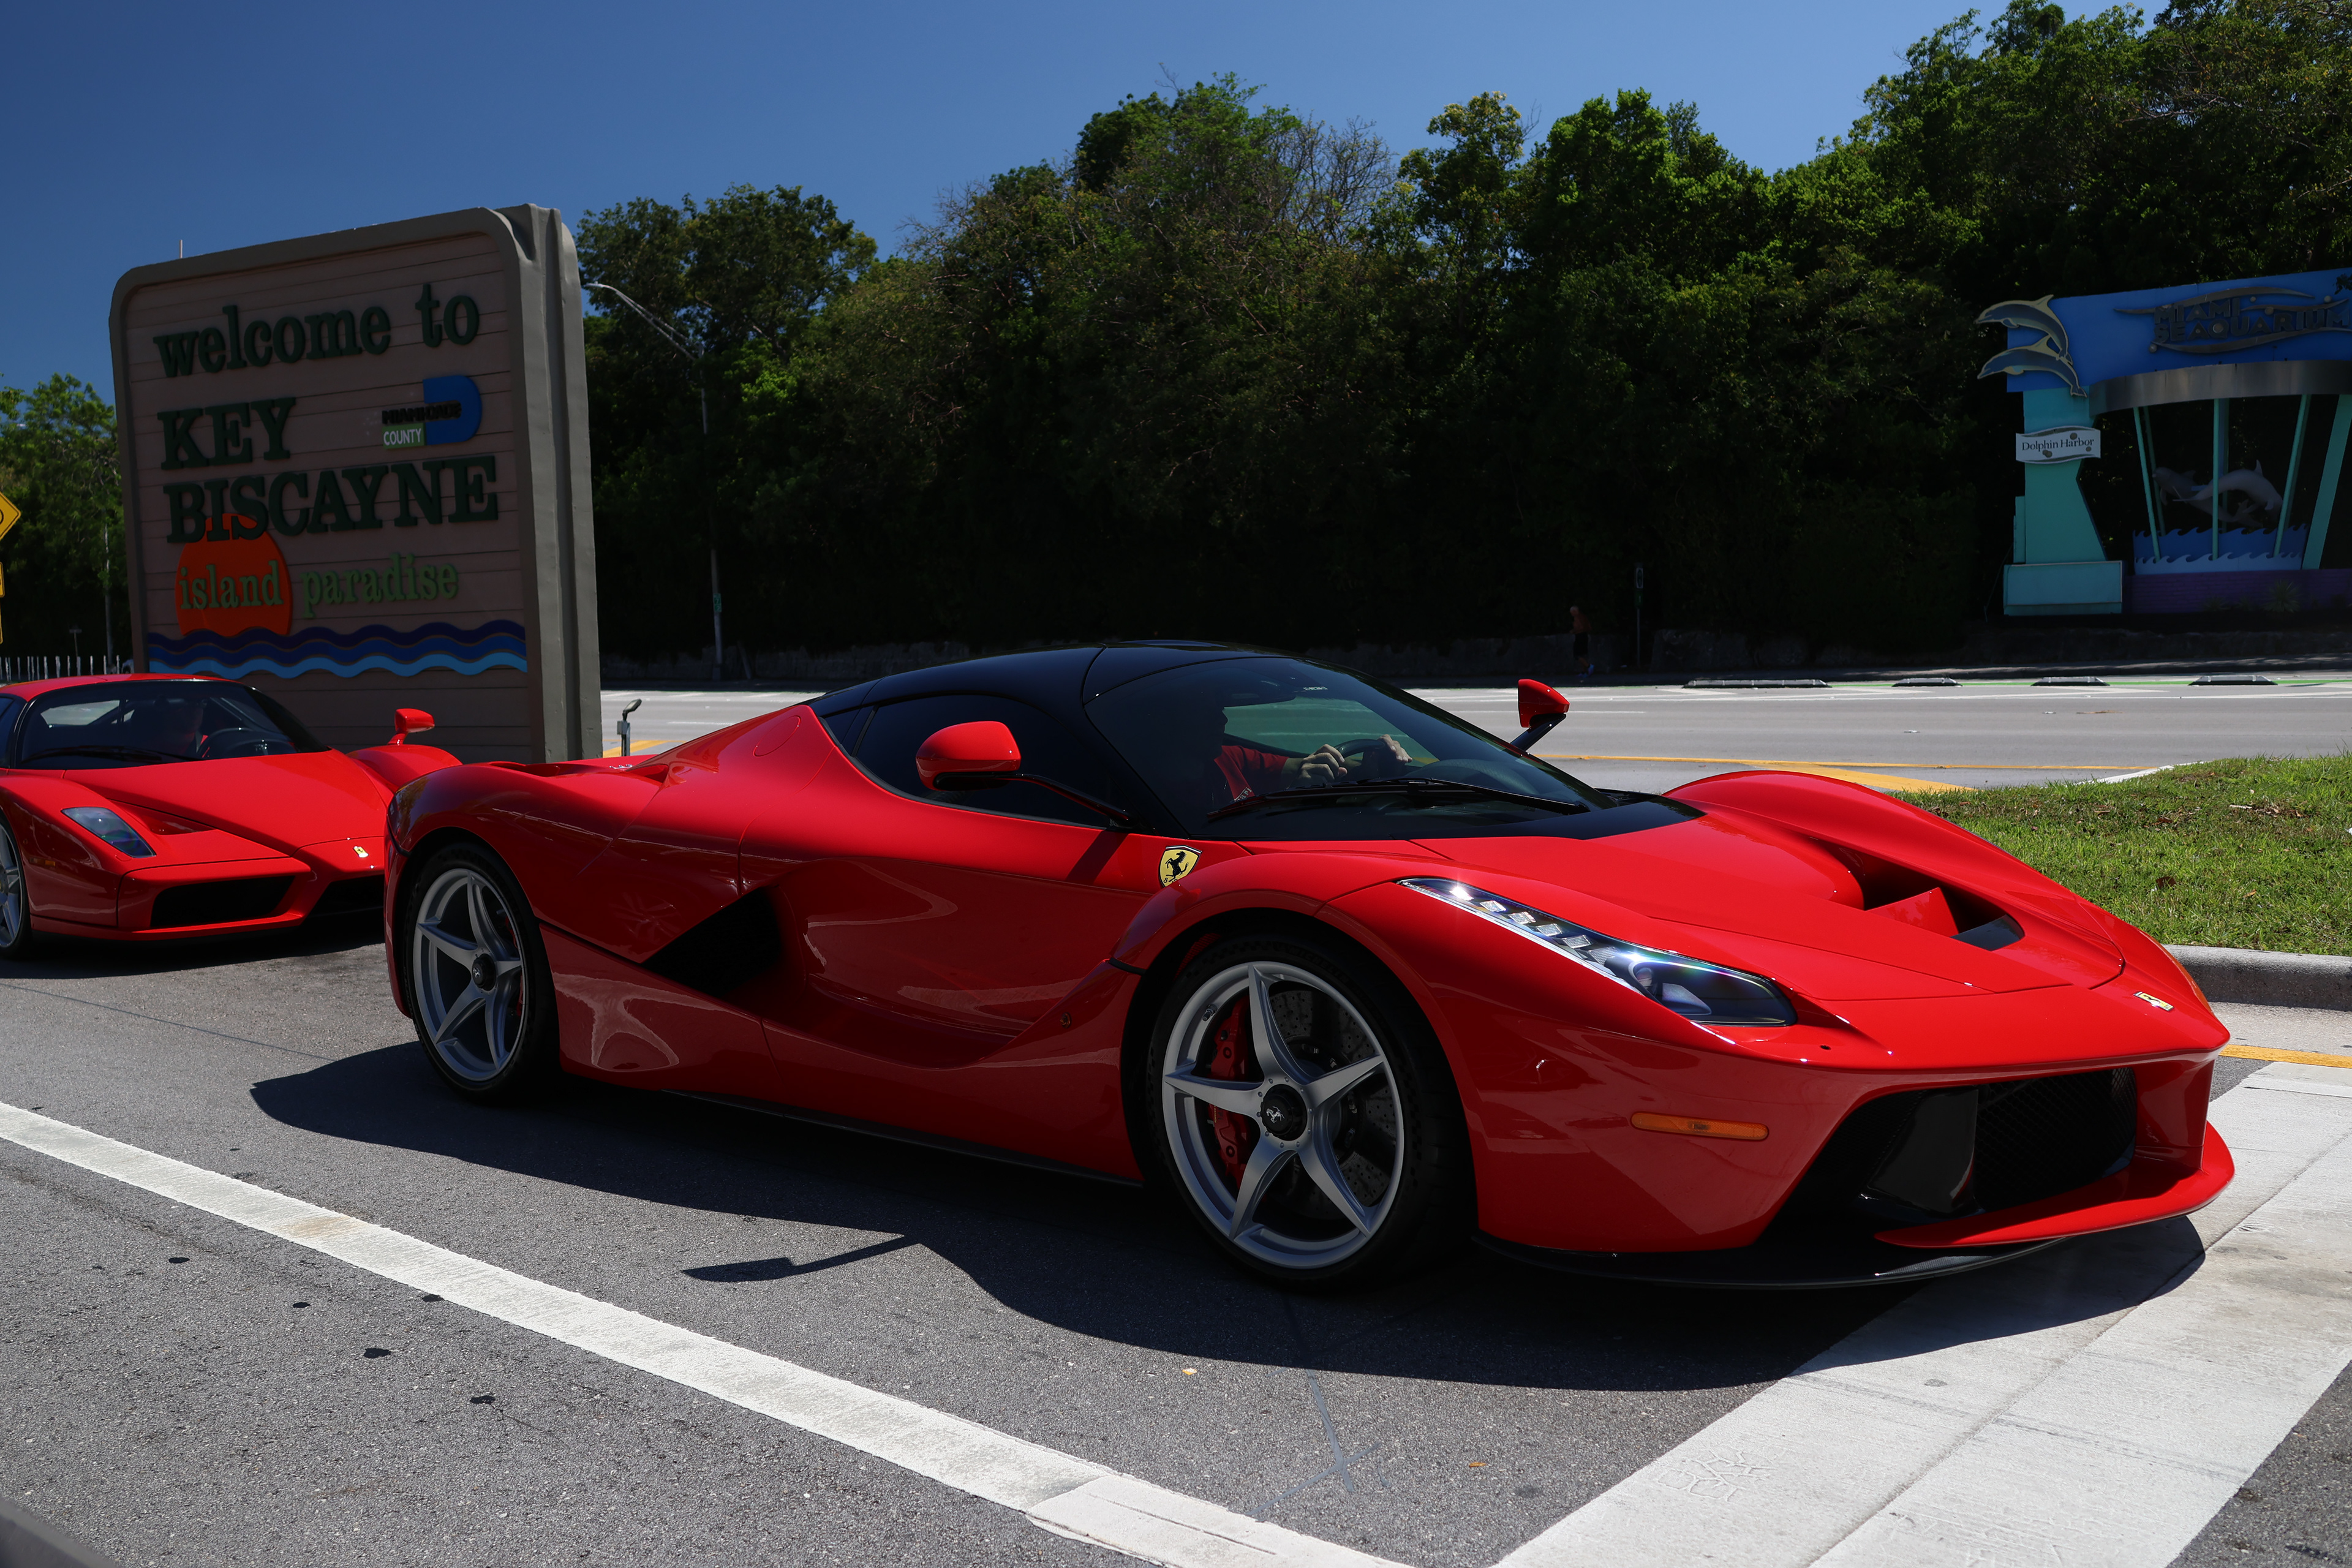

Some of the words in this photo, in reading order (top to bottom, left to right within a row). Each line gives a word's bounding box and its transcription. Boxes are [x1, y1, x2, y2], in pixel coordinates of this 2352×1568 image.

[2154, 298, 2240, 323] MIAMI
[2154, 309, 2350, 342] SEAQUARIUM
[153, 305, 391, 378] welcome
[415, 284, 480, 347] to
[157, 398, 296, 470] KEY
[383, 428, 421, 446] COUNTY
[2022, 440, 2059, 452] Dolphin
[2060, 437, 2094, 448] Harbor
[163, 456, 498, 543] BISCAYNE
[180, 560, 284, 611] island
[300, 554, 459, 619] paradise
[1287, 944, 1349, 983] MICHELIN
